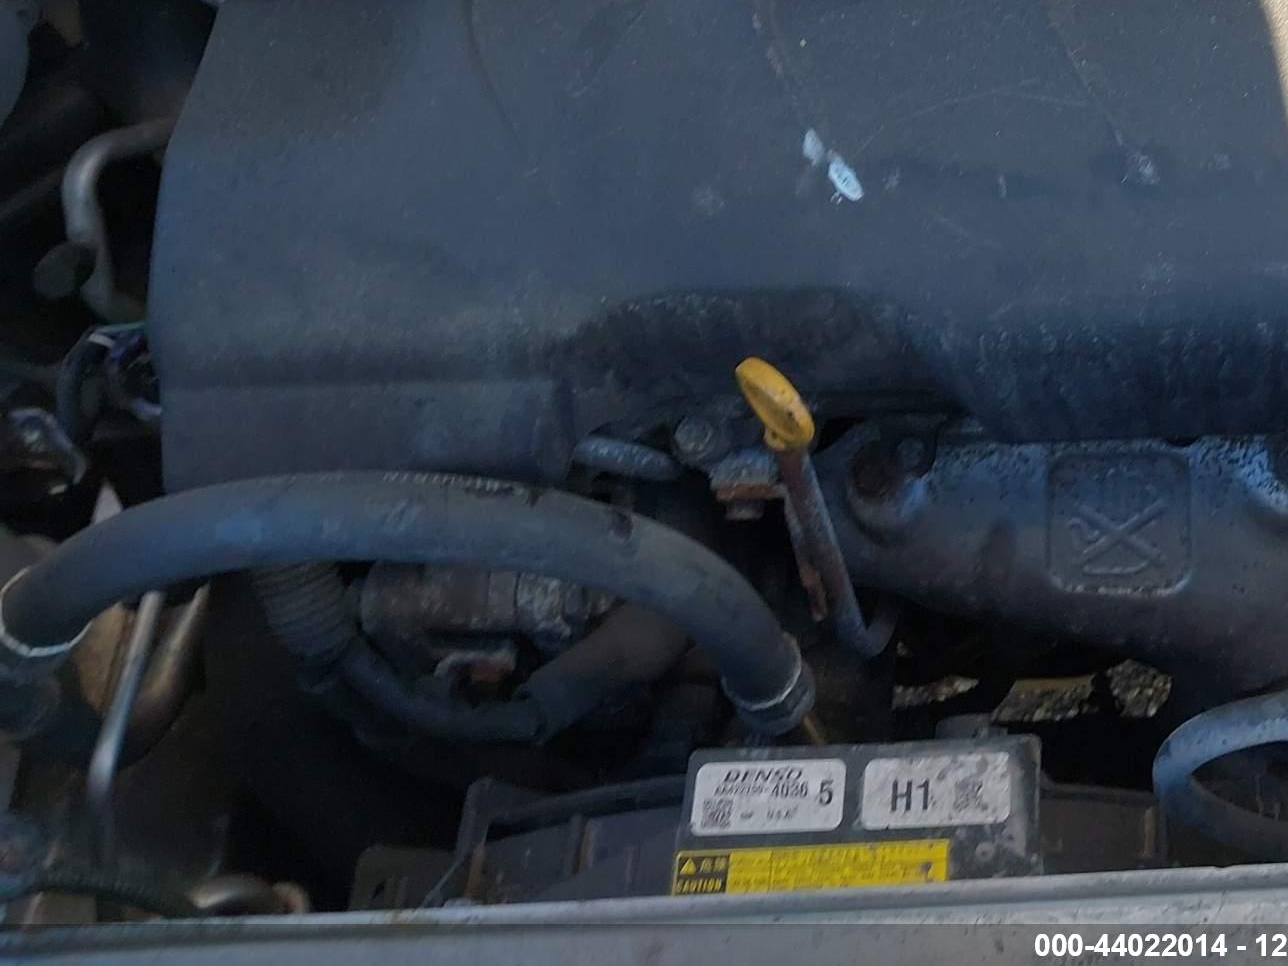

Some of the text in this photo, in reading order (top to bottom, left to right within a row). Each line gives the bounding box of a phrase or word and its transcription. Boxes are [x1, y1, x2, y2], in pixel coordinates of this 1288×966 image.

[723, 766, 803, 783] DENSO
[817, 777, 835, 806] 5
[890, 779, 931, 812] H1
